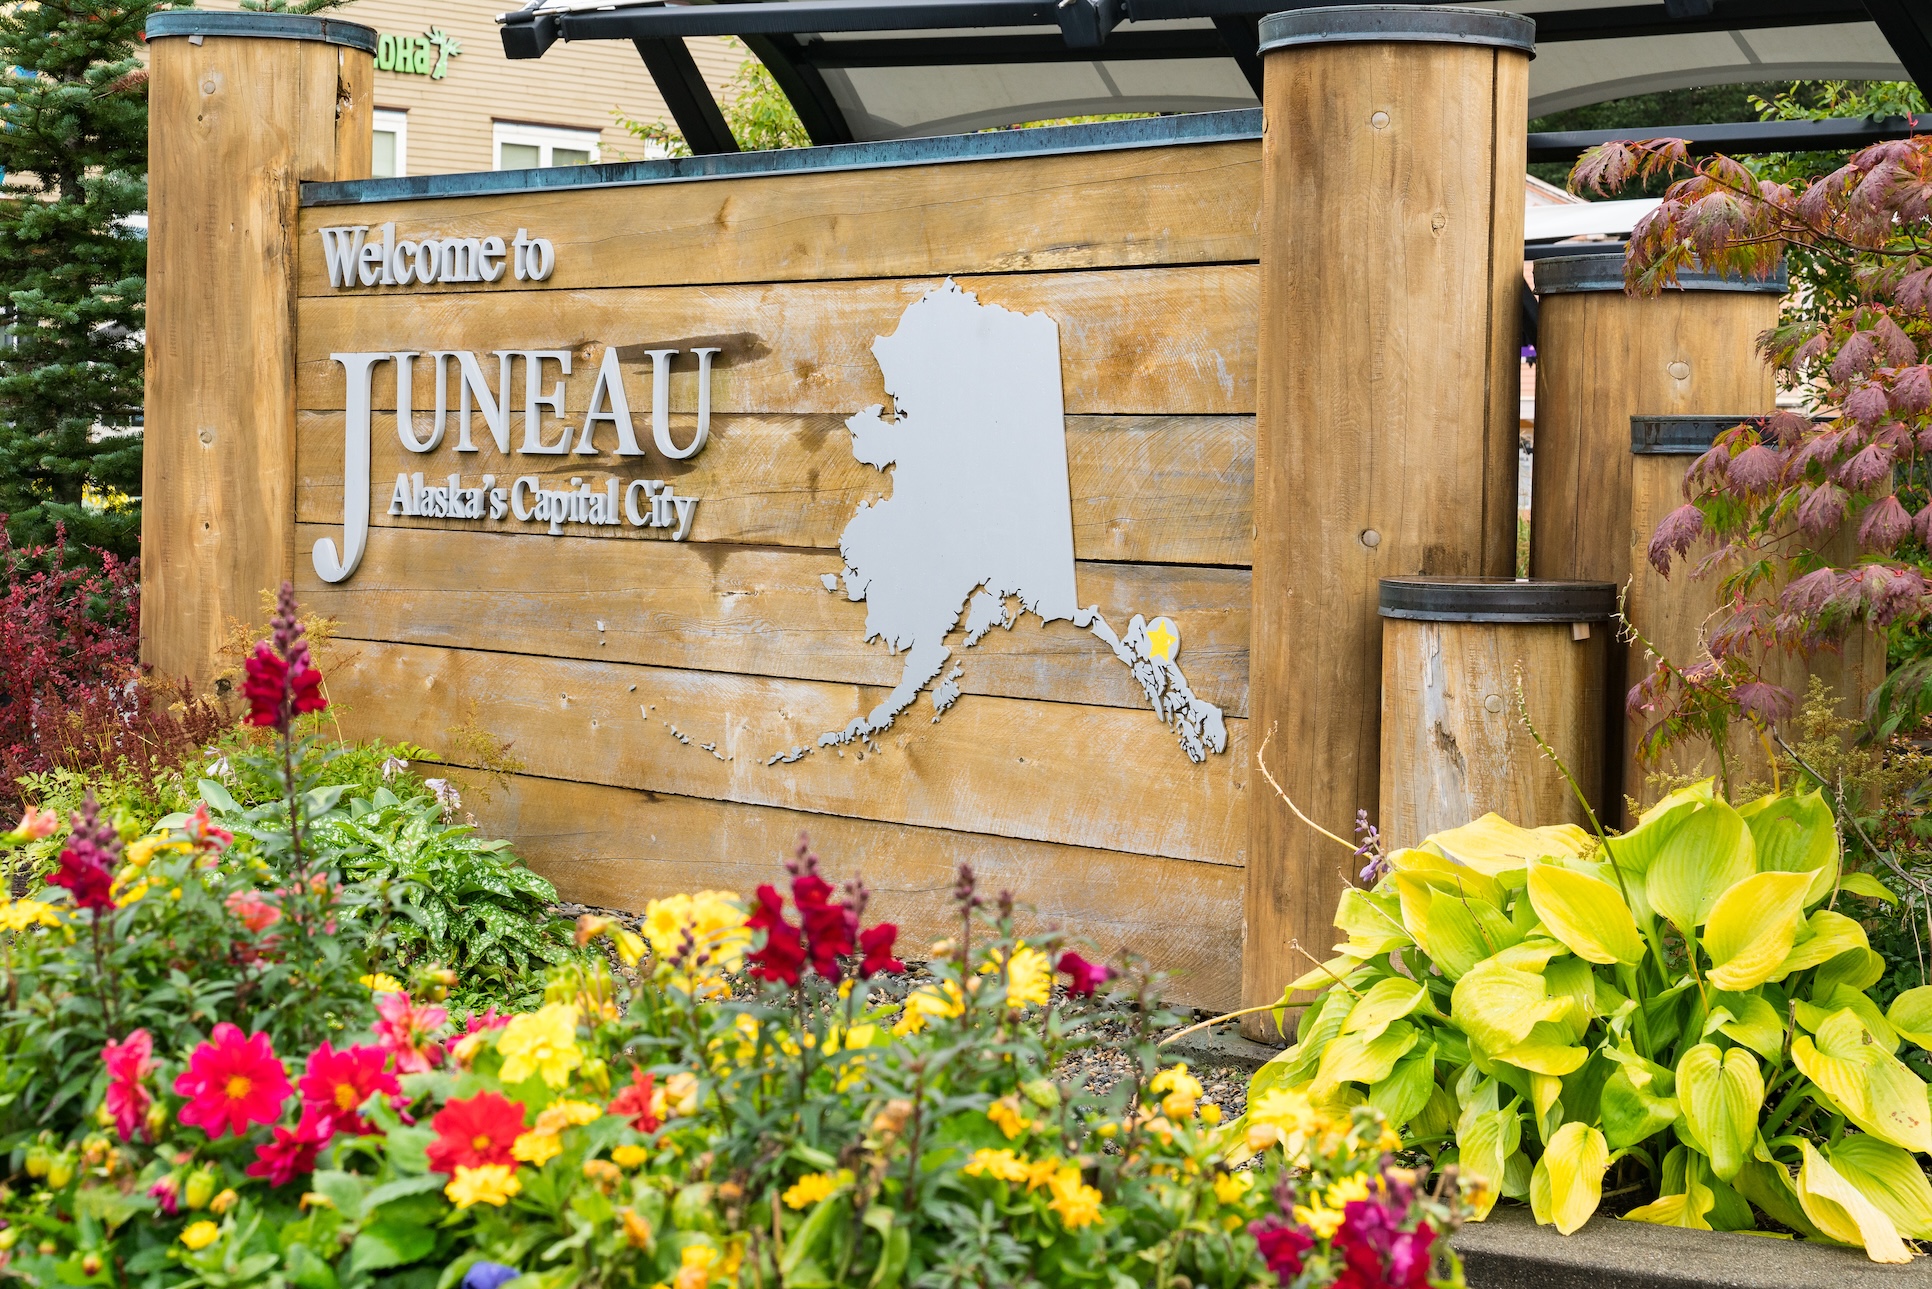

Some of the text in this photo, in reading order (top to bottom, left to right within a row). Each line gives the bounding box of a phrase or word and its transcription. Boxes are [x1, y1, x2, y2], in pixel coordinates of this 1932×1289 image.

[319, 222, 555, 288] Welcome to
[312, 346, 721, 583] JUNEAU
[387, 472, 699, 542] Alaska's Capital City
